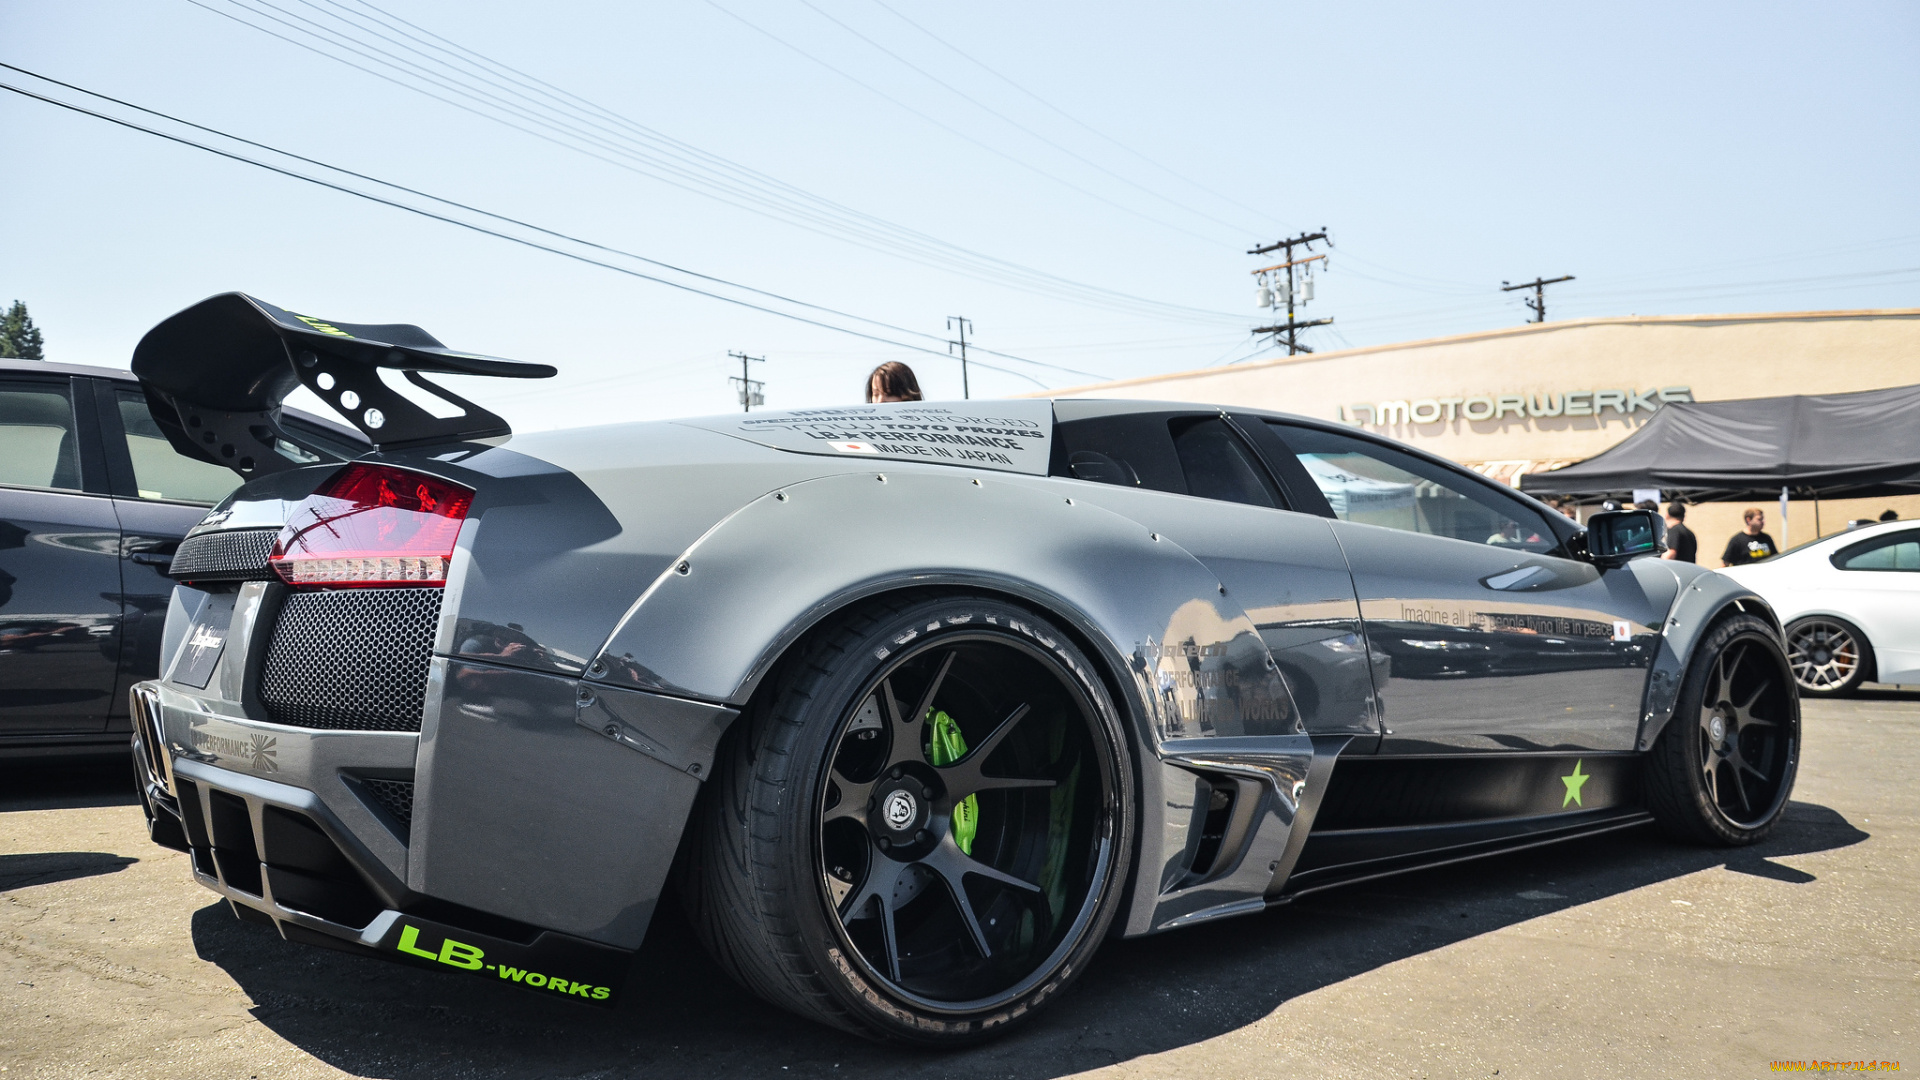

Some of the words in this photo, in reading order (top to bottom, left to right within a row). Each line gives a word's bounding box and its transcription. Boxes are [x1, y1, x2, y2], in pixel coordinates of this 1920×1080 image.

[881, 423, 949, 431] TOYO
[954, 425, 1045, 439] PROXES
[872, 443, 932, 456] MADE
[930, 446, 954, 458] IN
[955, 448, 1013, 465] JAPAN
[1401, 603, 1449, 628] Imagine
[1452, 611, 1465, 627] all
[1468, 610, 1486, 627] the
[1489, 614, 1525, 632] people
[1526, 614, 1554, 636] living
[1555, 616, 1570, 635] life
[1572, 617, 1582, 636] in
[1583, 620, 1612, 640] peace
[396, 924, 612, 1000] LB-WORKS
